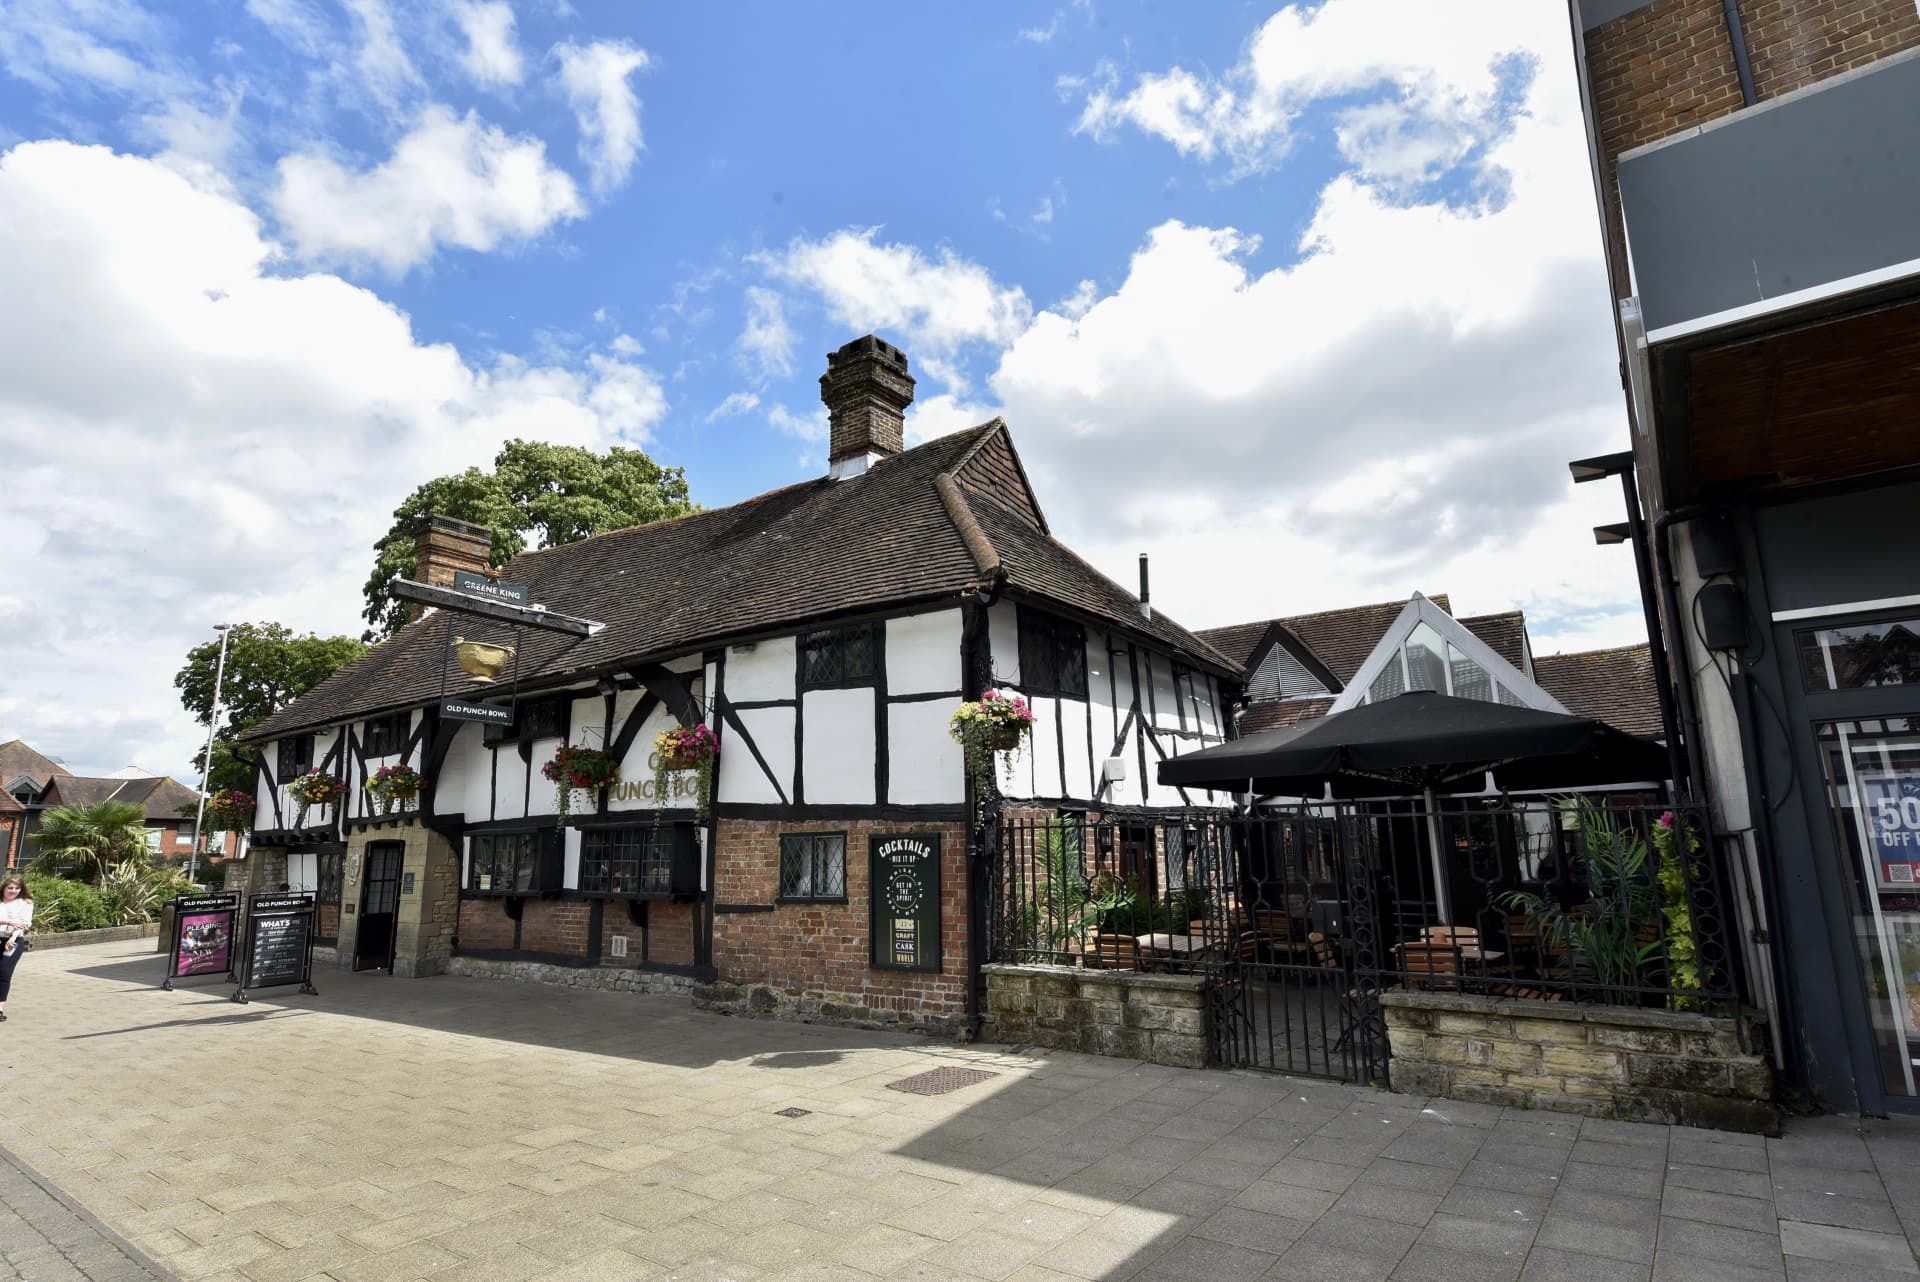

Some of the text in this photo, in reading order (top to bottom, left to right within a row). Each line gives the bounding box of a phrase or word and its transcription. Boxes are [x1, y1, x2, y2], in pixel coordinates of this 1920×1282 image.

[464, 581, 497, 594] GREENE
[500, 589, 520, 600] KING
[446, 704, 508, 718] OLD PUNCH BOWL
[607, 779, 666, 801] PUNC
[1884, 831, 1911, 847] OFF
[878, 839, 931, 858] COCKTAILS
[902, 855, 908, 863] IT
[186, 922, 222, 931] PLEASING
[895, 942, 914, 951] CASK
